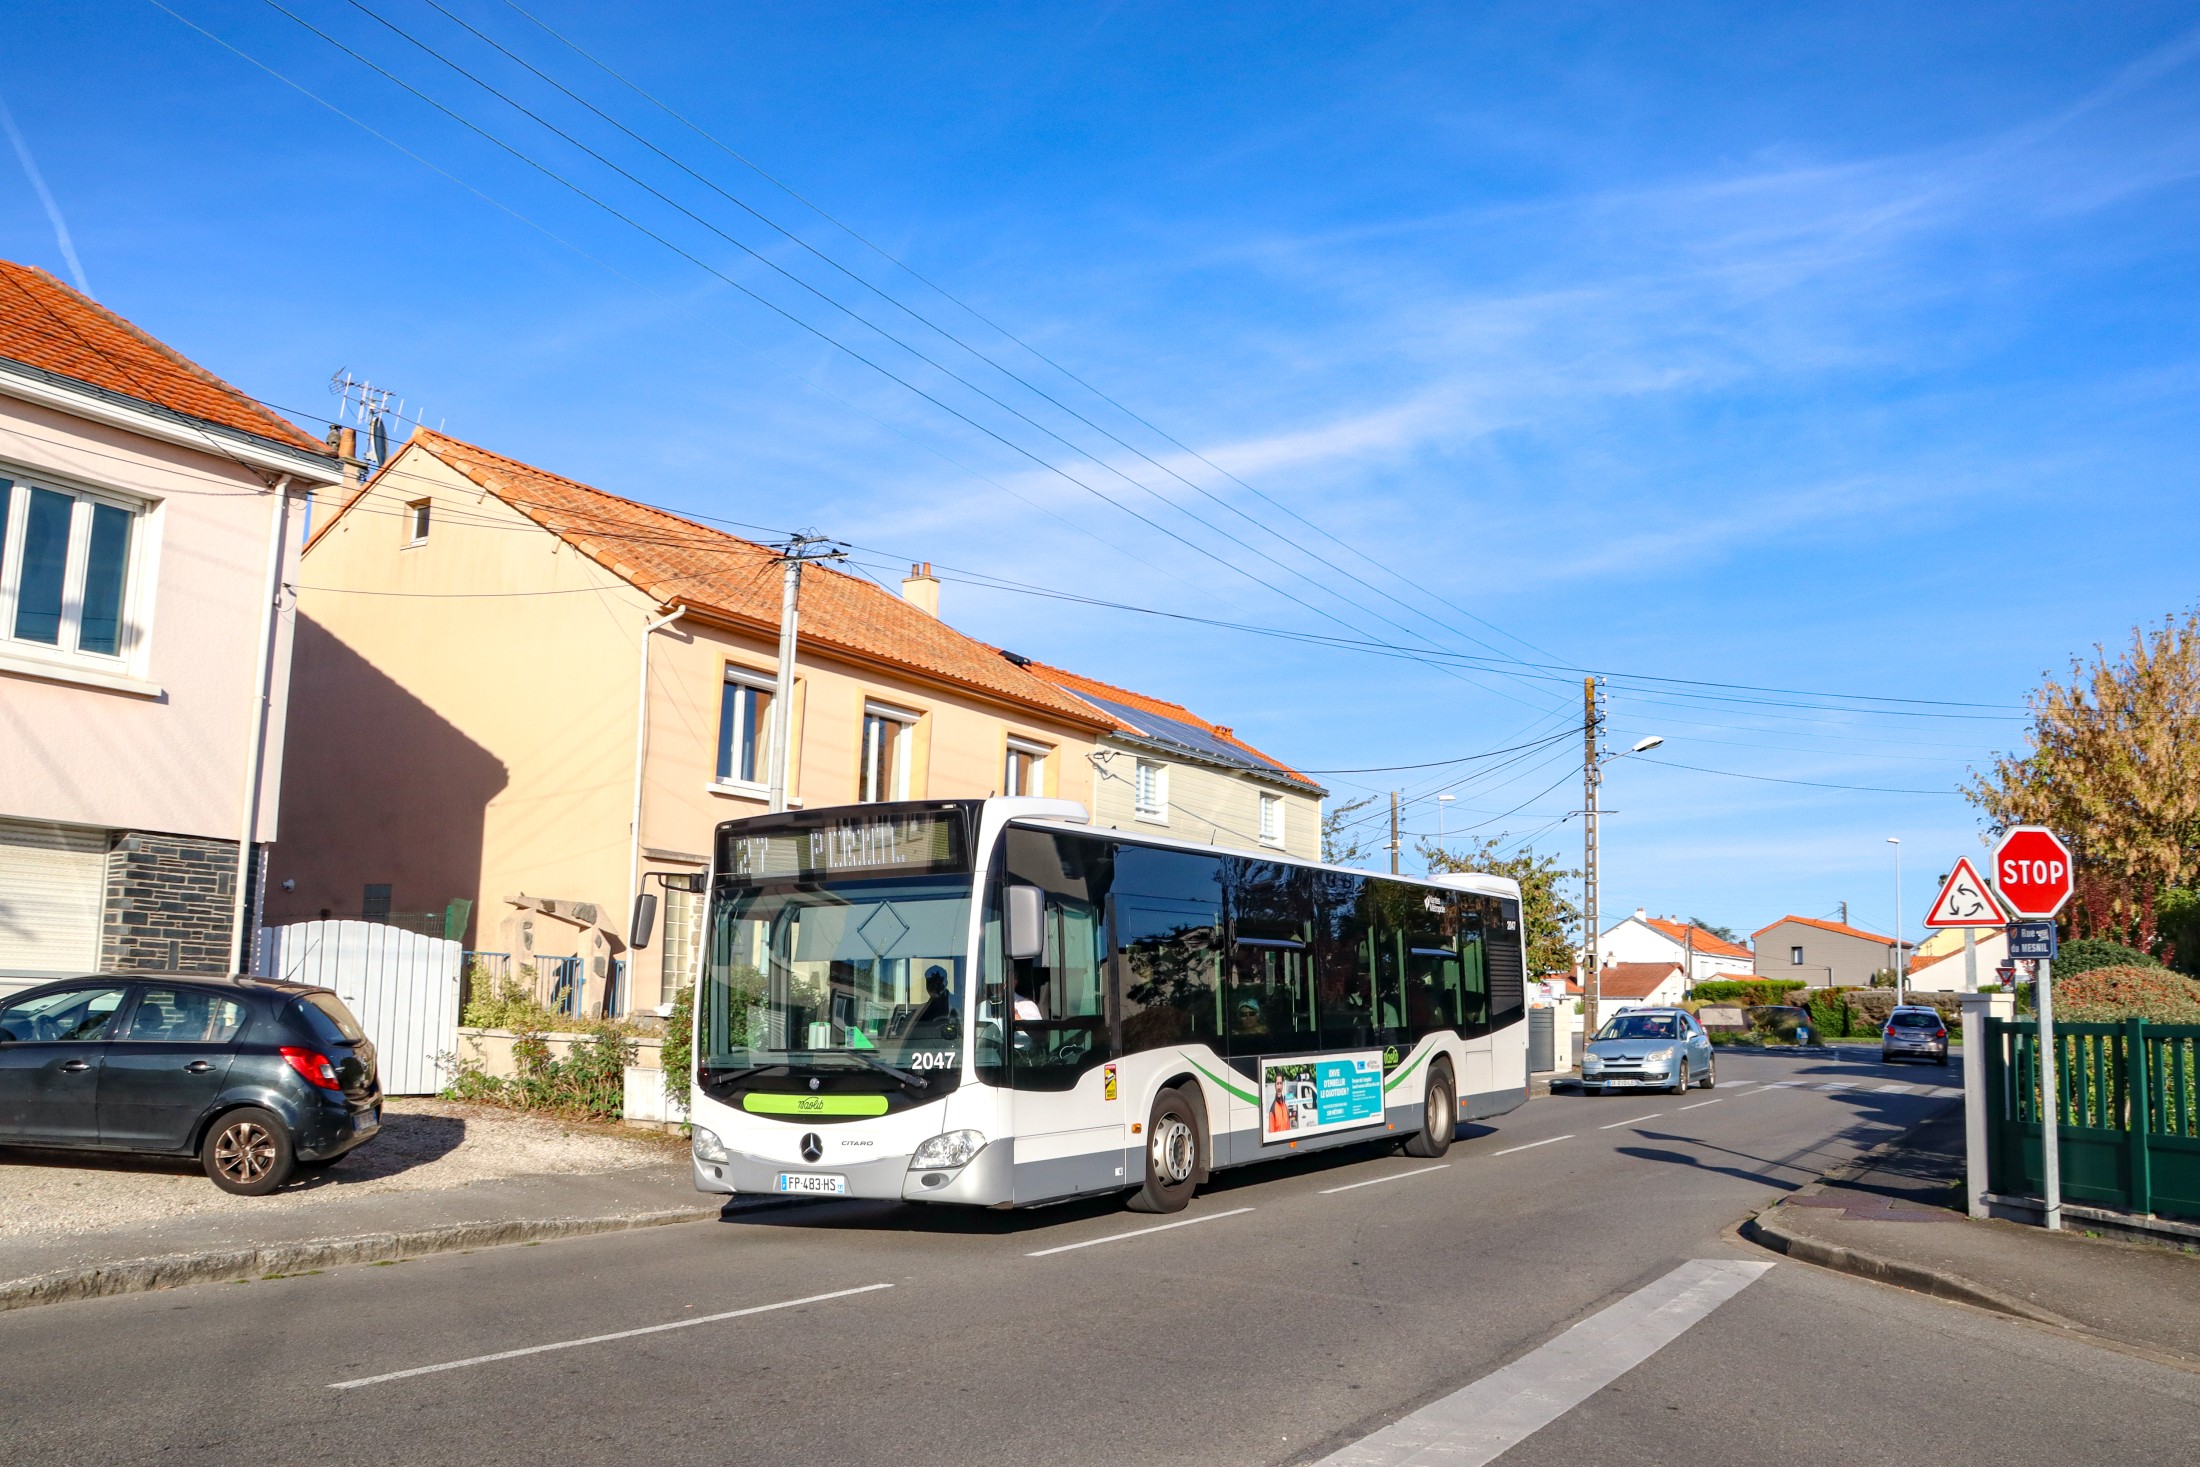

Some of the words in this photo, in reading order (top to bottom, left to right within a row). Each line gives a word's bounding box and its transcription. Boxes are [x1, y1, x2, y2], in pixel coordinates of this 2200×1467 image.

[736, 837, 768, 874] 27
[2003, 859, 2064, 885] STOP
[1506, 920, 1517, 931] 2047
[2021, 929, 2036, 937] Rue
[2011, 944, 2020, 952] du
[2021, 943, 2048, 952] MESNIL
[911, 1051, 956, 1070] 2047
